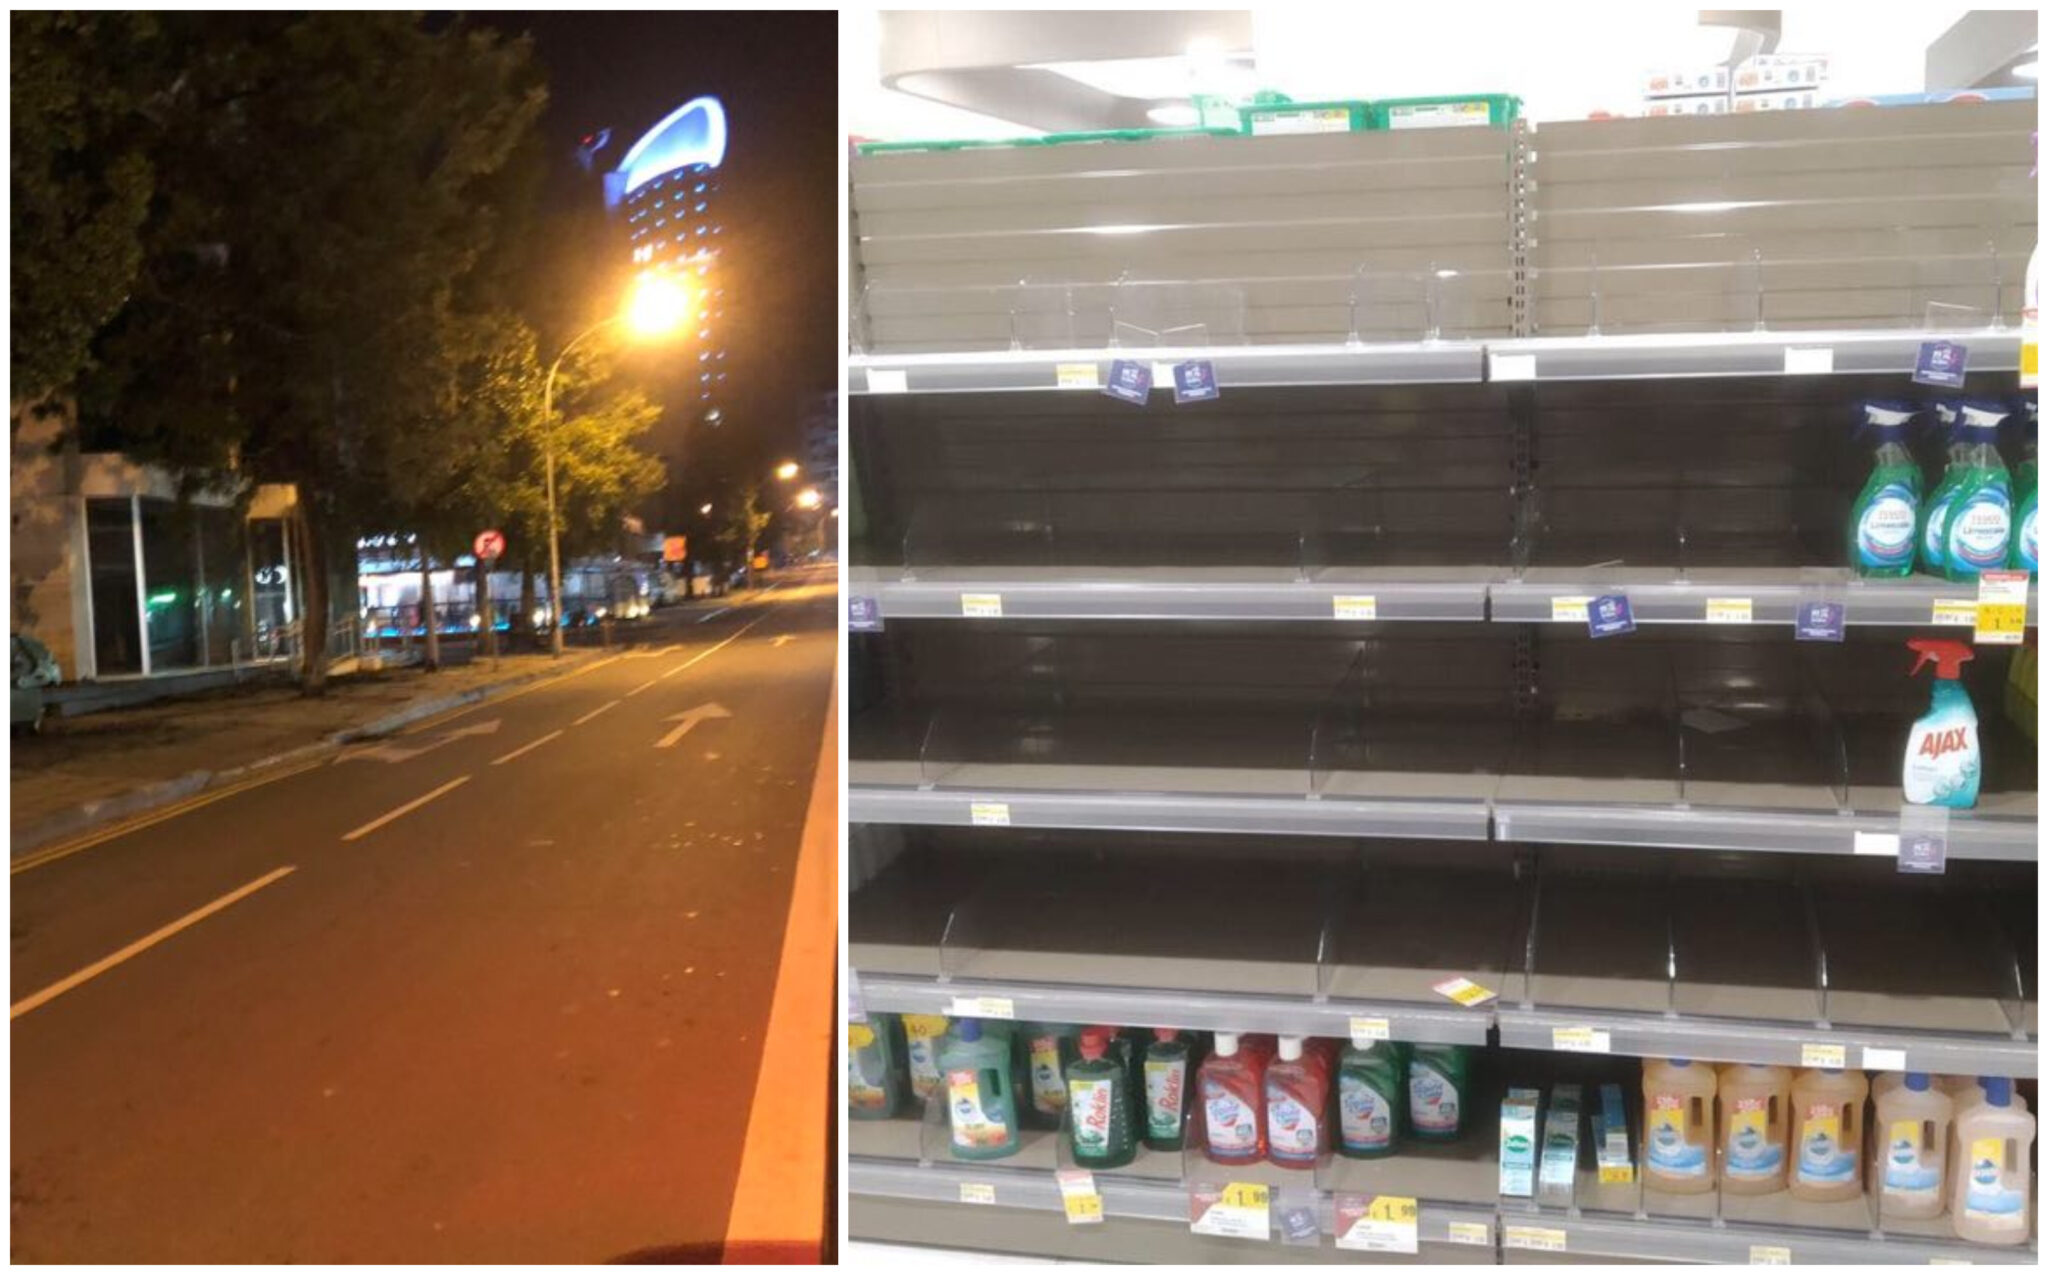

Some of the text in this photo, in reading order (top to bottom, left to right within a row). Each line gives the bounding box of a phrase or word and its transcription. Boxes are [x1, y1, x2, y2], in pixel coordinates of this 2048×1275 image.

[1919, 727, 1968, 760] AJAX
[1086, 1087, 1108, 1131] Roklin
[1159, 1069, 1181, 1111] Roklin
